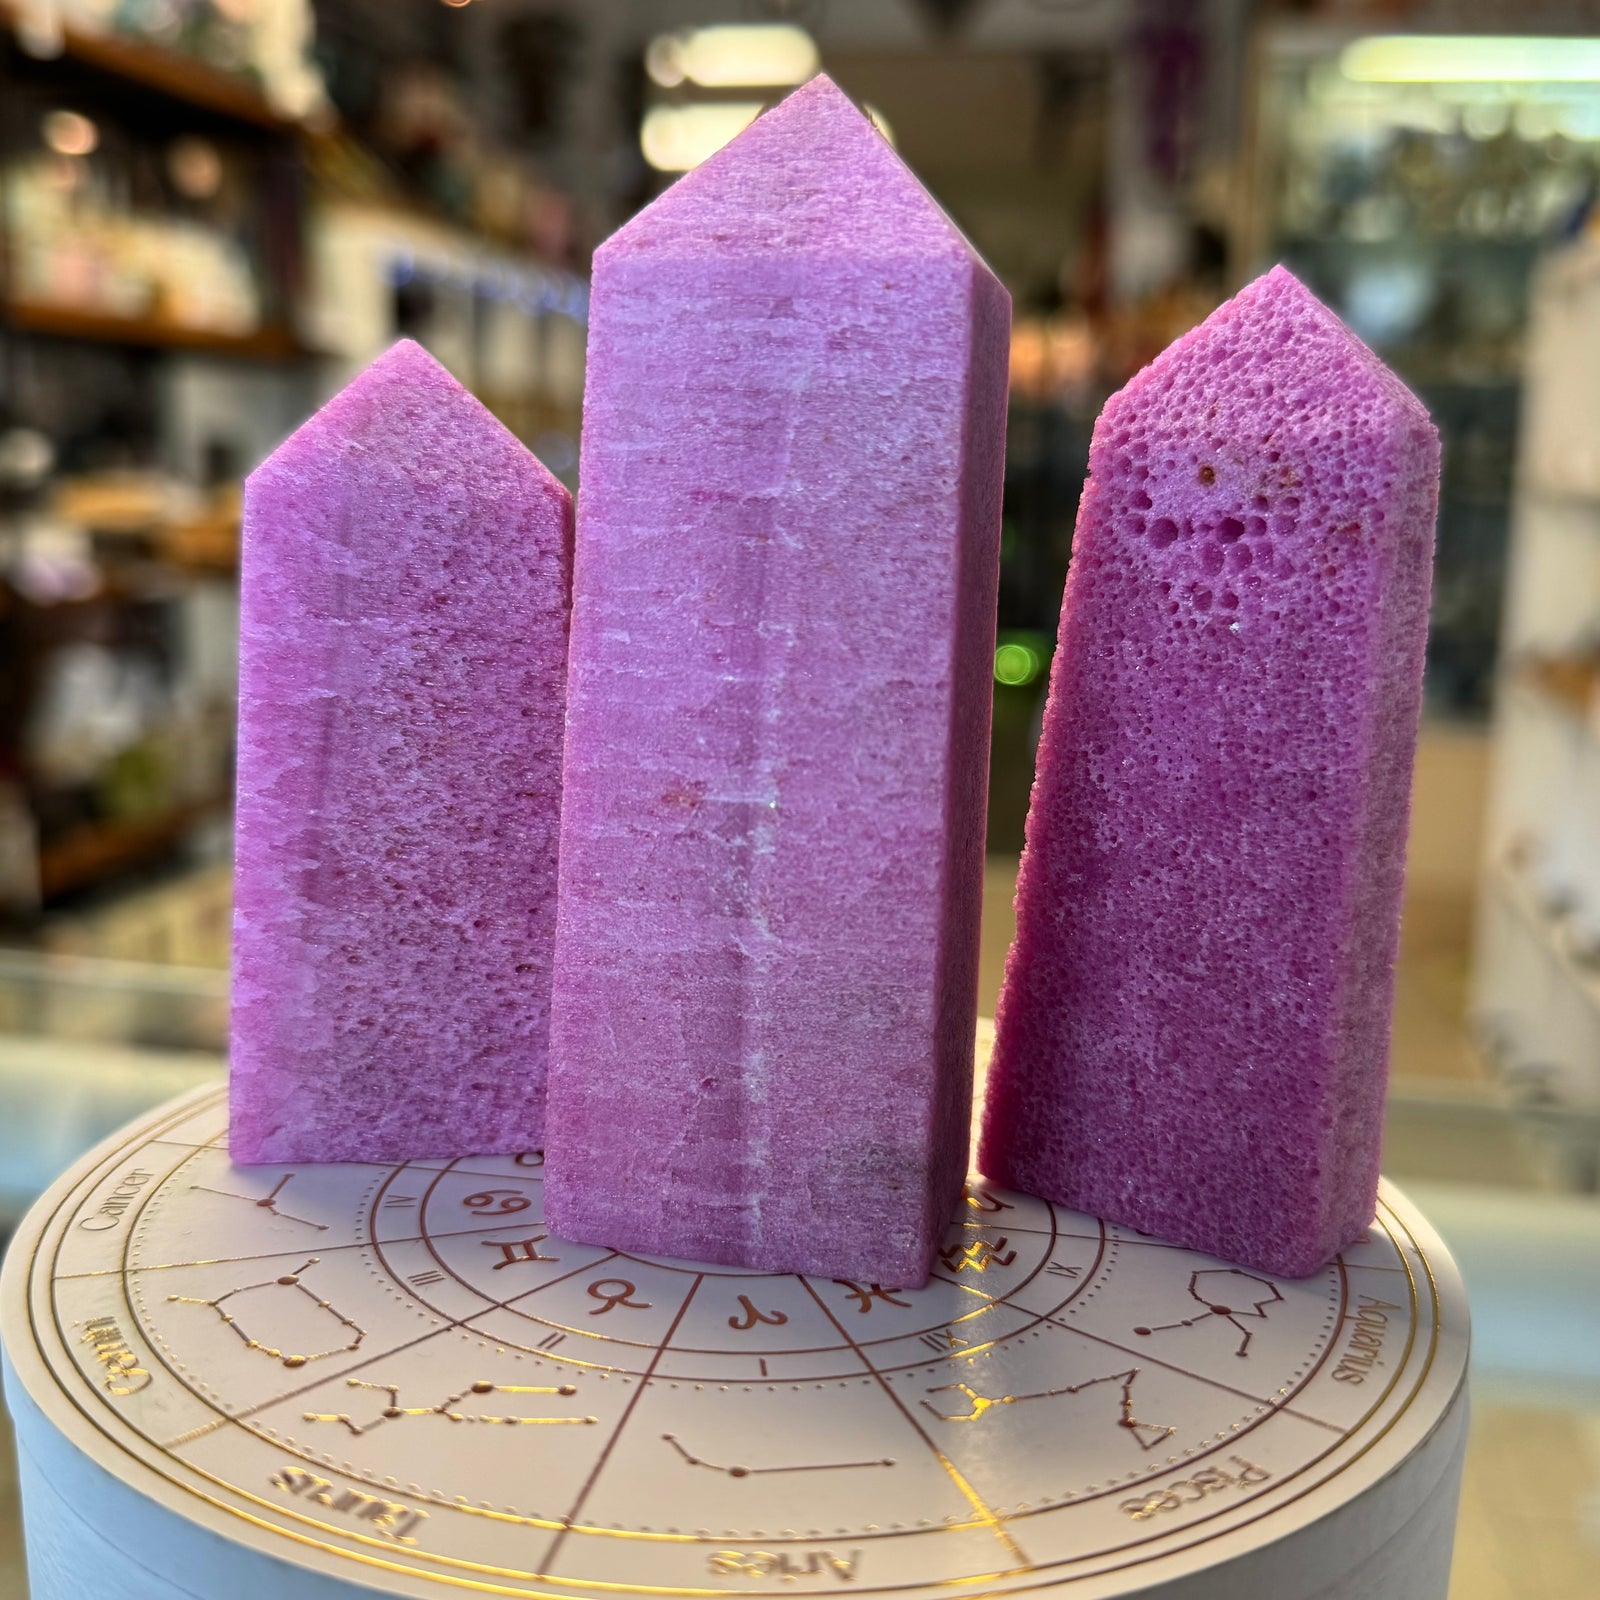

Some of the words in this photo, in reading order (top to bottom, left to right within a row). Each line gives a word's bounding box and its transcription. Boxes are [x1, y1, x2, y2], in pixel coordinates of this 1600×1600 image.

[80, 1168, 154, 1231] Cancer
[74, 1315, 153, 1395] Gemini
[1331, 1294, 1402, 1385] Aquarius
[267, 1465, 431, 1546] Taurus
[1119, 1454, 1271, 1521] Pisces
[706, 1548, 862, 1583] Aries
